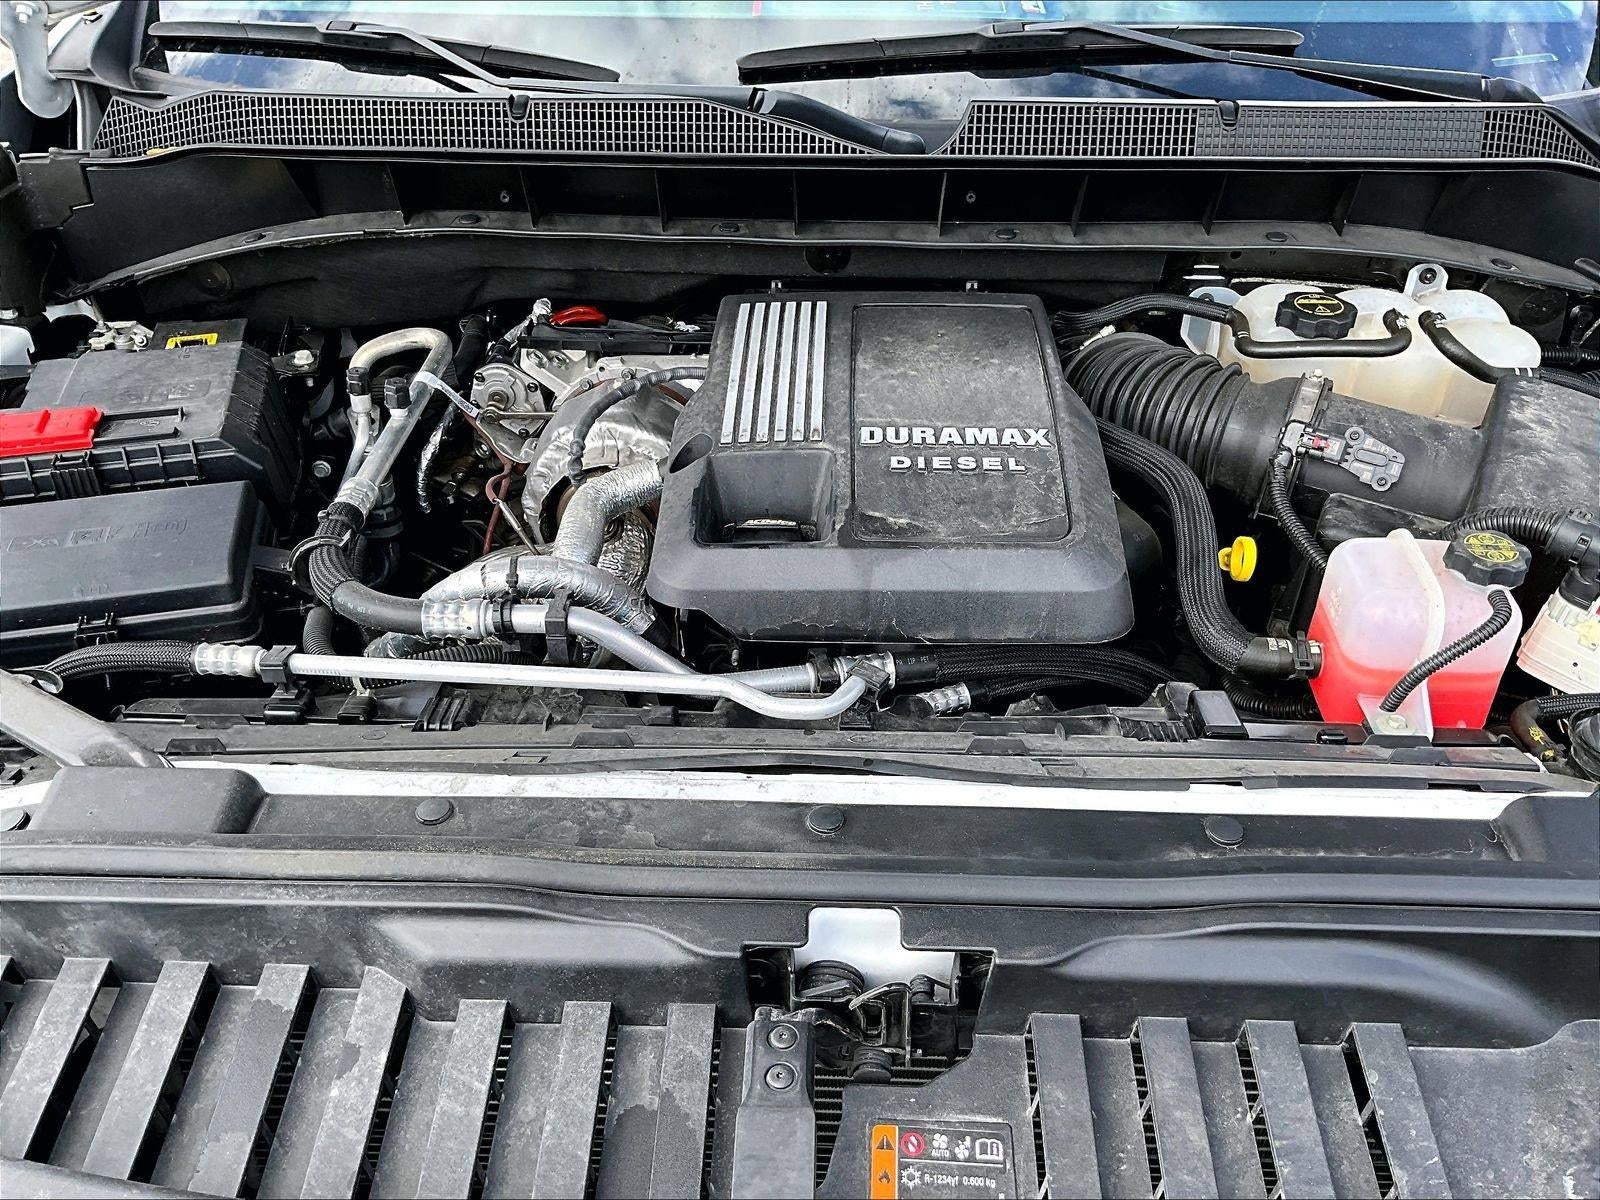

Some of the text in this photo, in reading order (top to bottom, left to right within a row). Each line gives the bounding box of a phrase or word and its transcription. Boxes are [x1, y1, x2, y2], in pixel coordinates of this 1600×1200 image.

[859, 426, 1051, 446] DURAMAX
[890, 456, 1027, 472] DIESEL
[931, 1149, 950, 1158] AUTO
[924, 1173, 996, 1189] R-1234yf 0.600 kg
